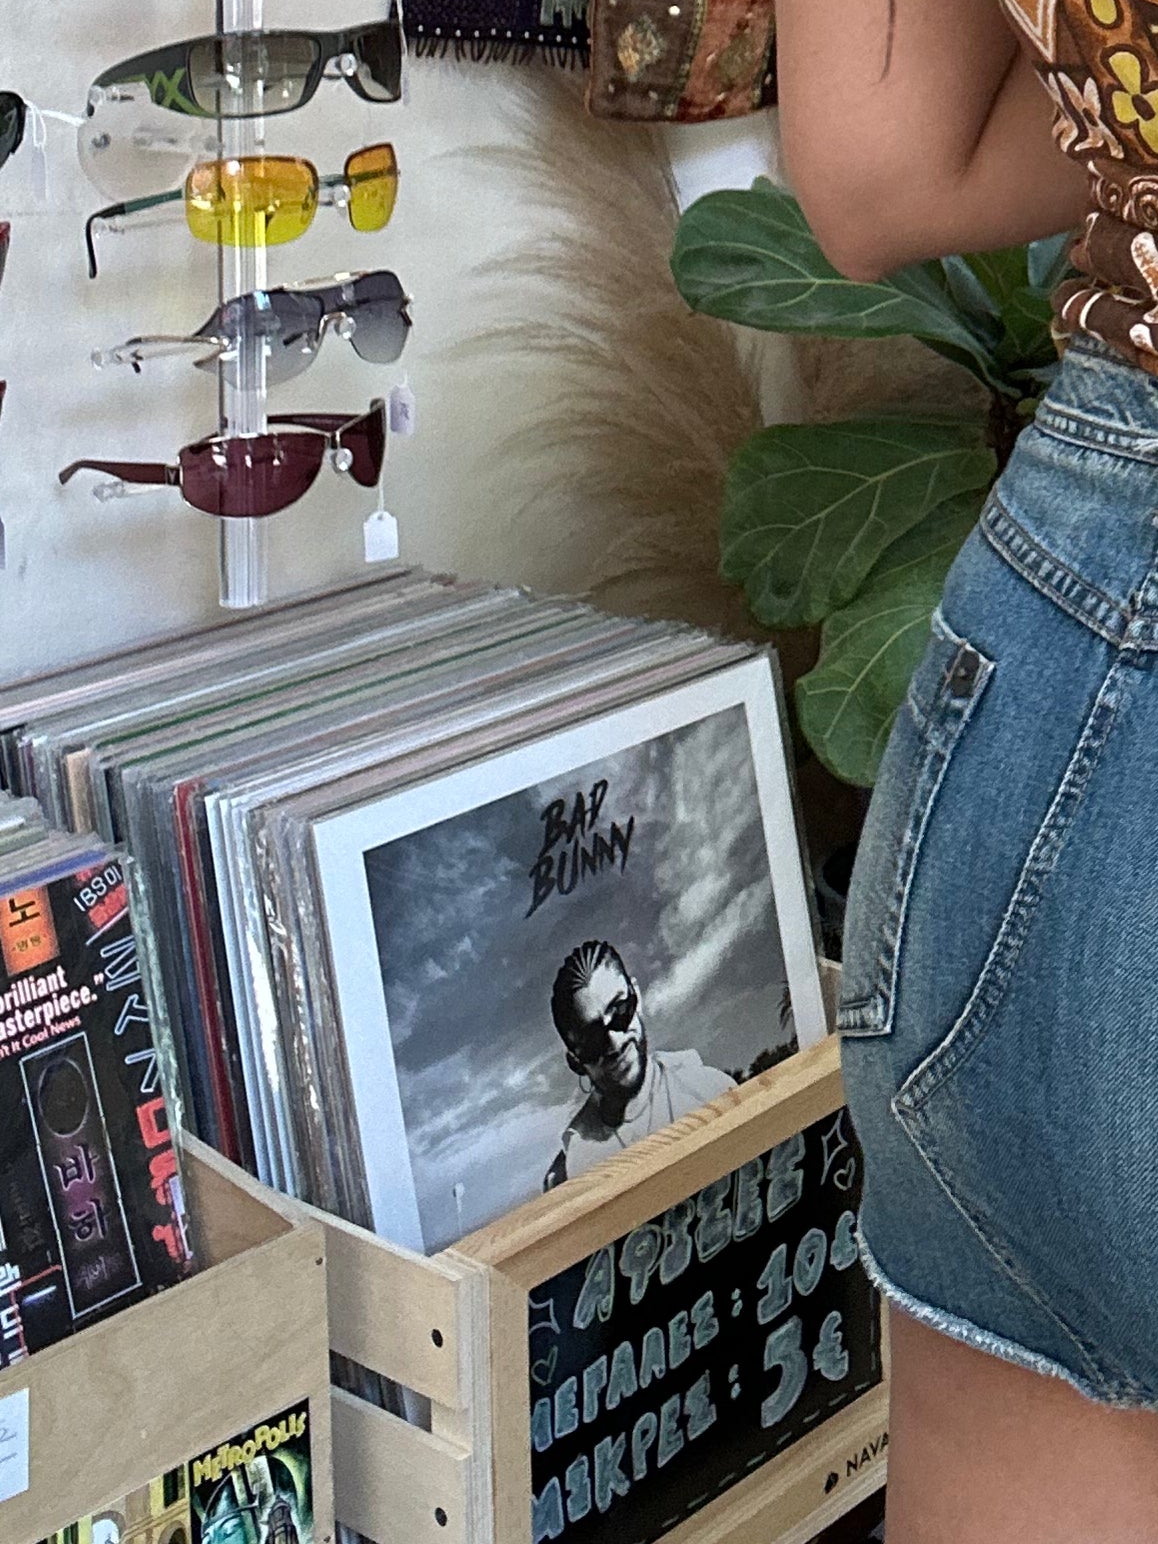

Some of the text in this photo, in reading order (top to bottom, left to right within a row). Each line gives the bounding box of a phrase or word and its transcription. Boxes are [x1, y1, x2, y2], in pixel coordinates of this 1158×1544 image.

[537, 779, 609, 858] BAD
[524, 815, 635, 919] BUNNY
[22, 1026, 50, 1049] Cool
[50, 1015, 82, 1037] News
[193, 1411, 307, 1487] METROPOLIS
